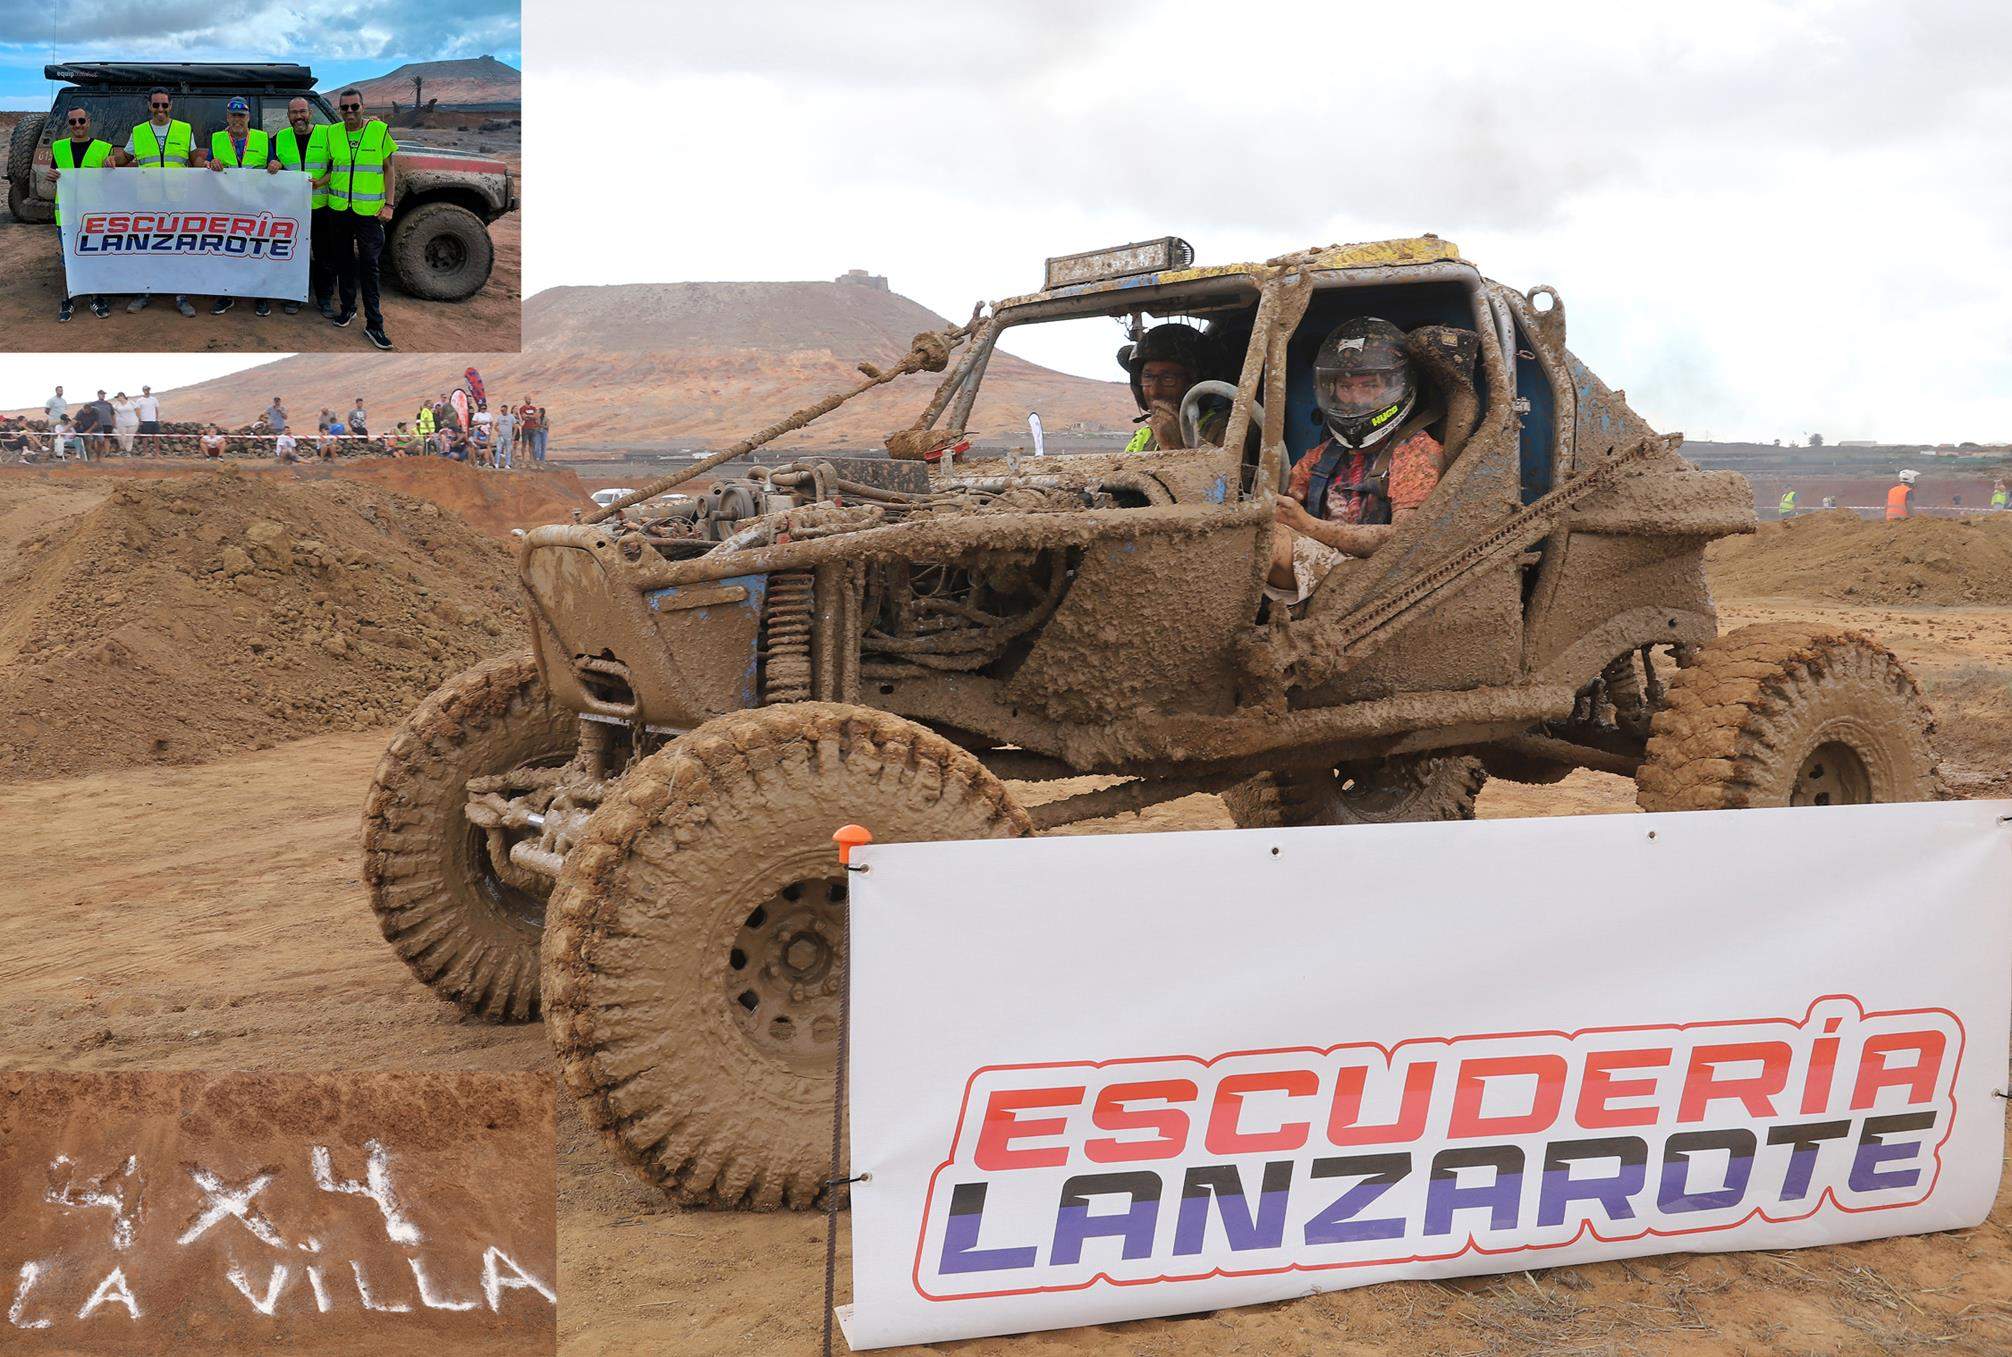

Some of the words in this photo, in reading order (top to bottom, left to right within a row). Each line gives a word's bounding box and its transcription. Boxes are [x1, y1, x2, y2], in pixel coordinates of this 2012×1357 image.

[79, 233, 292, 257] LANZAROTE
[85, 216, 294, 238] ESCUDERÍA
[974, 1016, 1947, 1172] ESCUDERÍA
[938, 1110, 1938, 1275] LANZAROTE
[9, 1261, 142, 1328] LA
